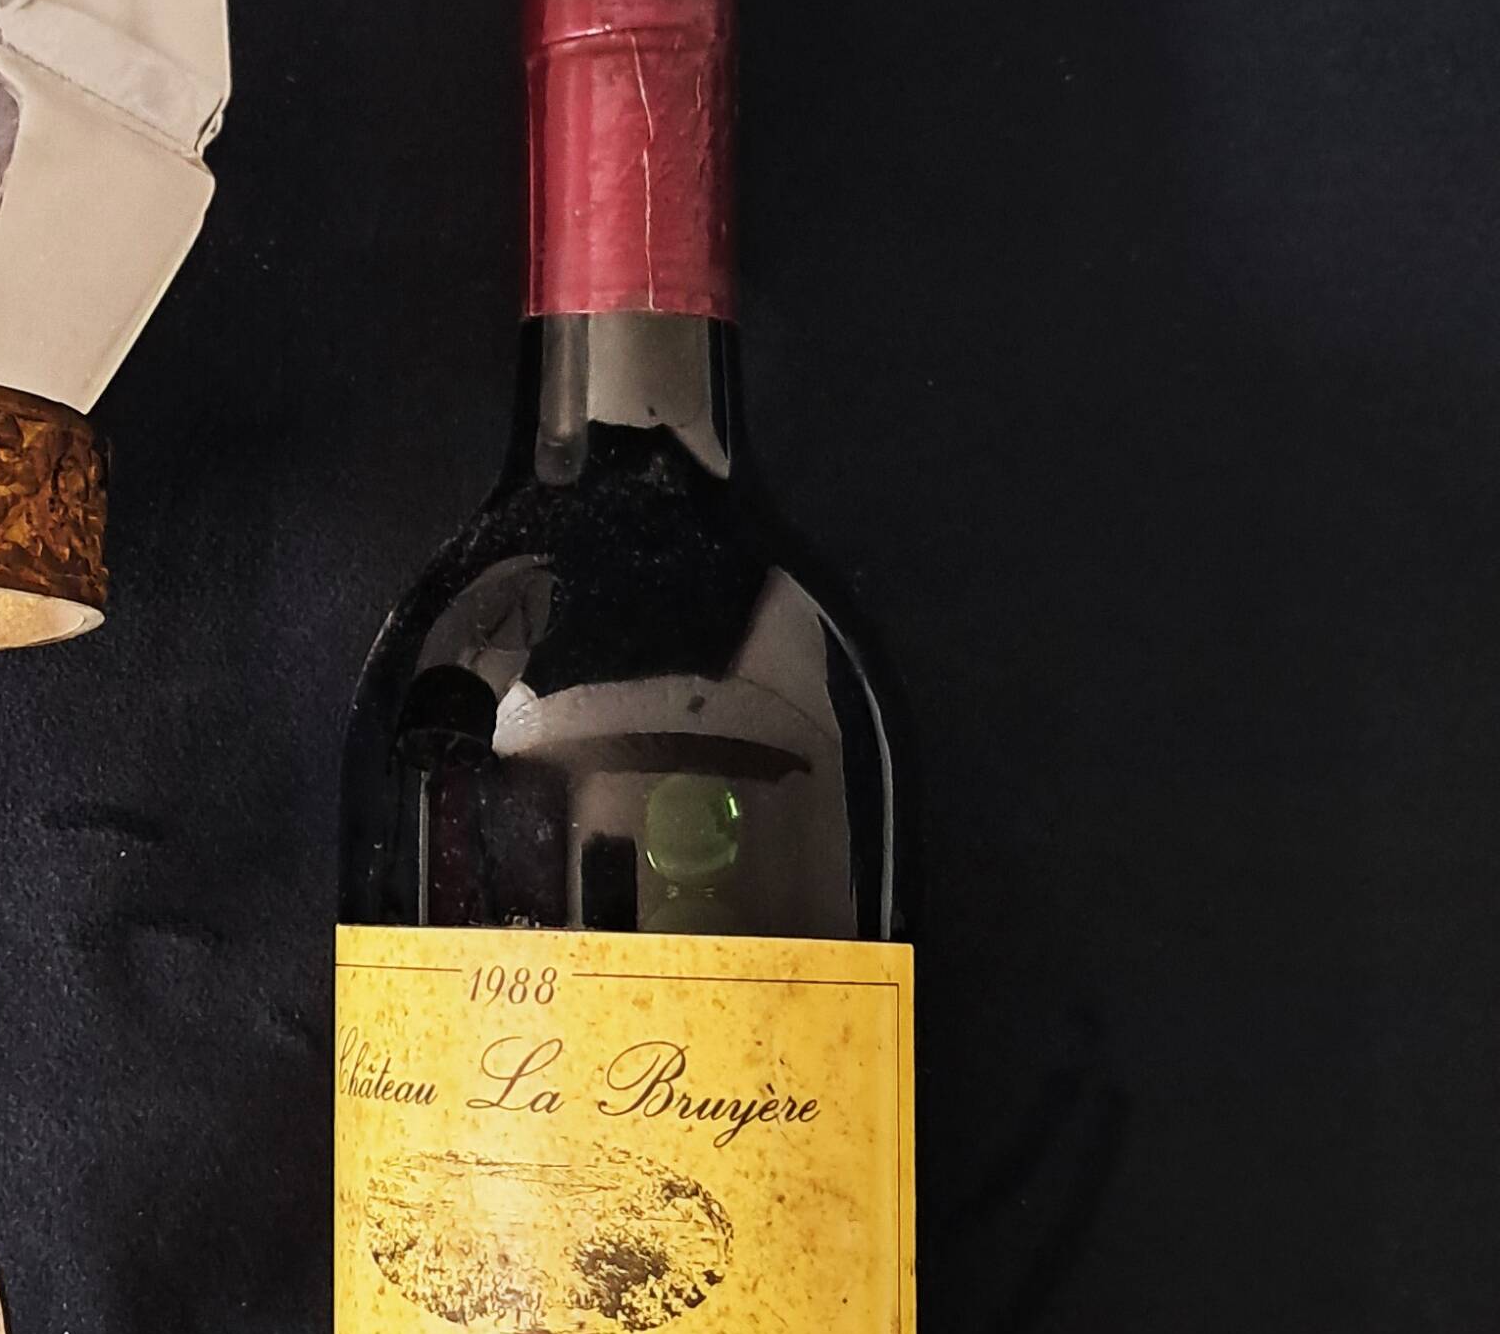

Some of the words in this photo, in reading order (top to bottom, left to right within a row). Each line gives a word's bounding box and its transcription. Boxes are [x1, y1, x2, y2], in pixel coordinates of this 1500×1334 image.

[468, 966, 557, 1005] 1988
[339, 1026, 438, 1105] Château
[466, 1036, 565, 1114] La
[598, 1041, 821, 1148] Bruyère
